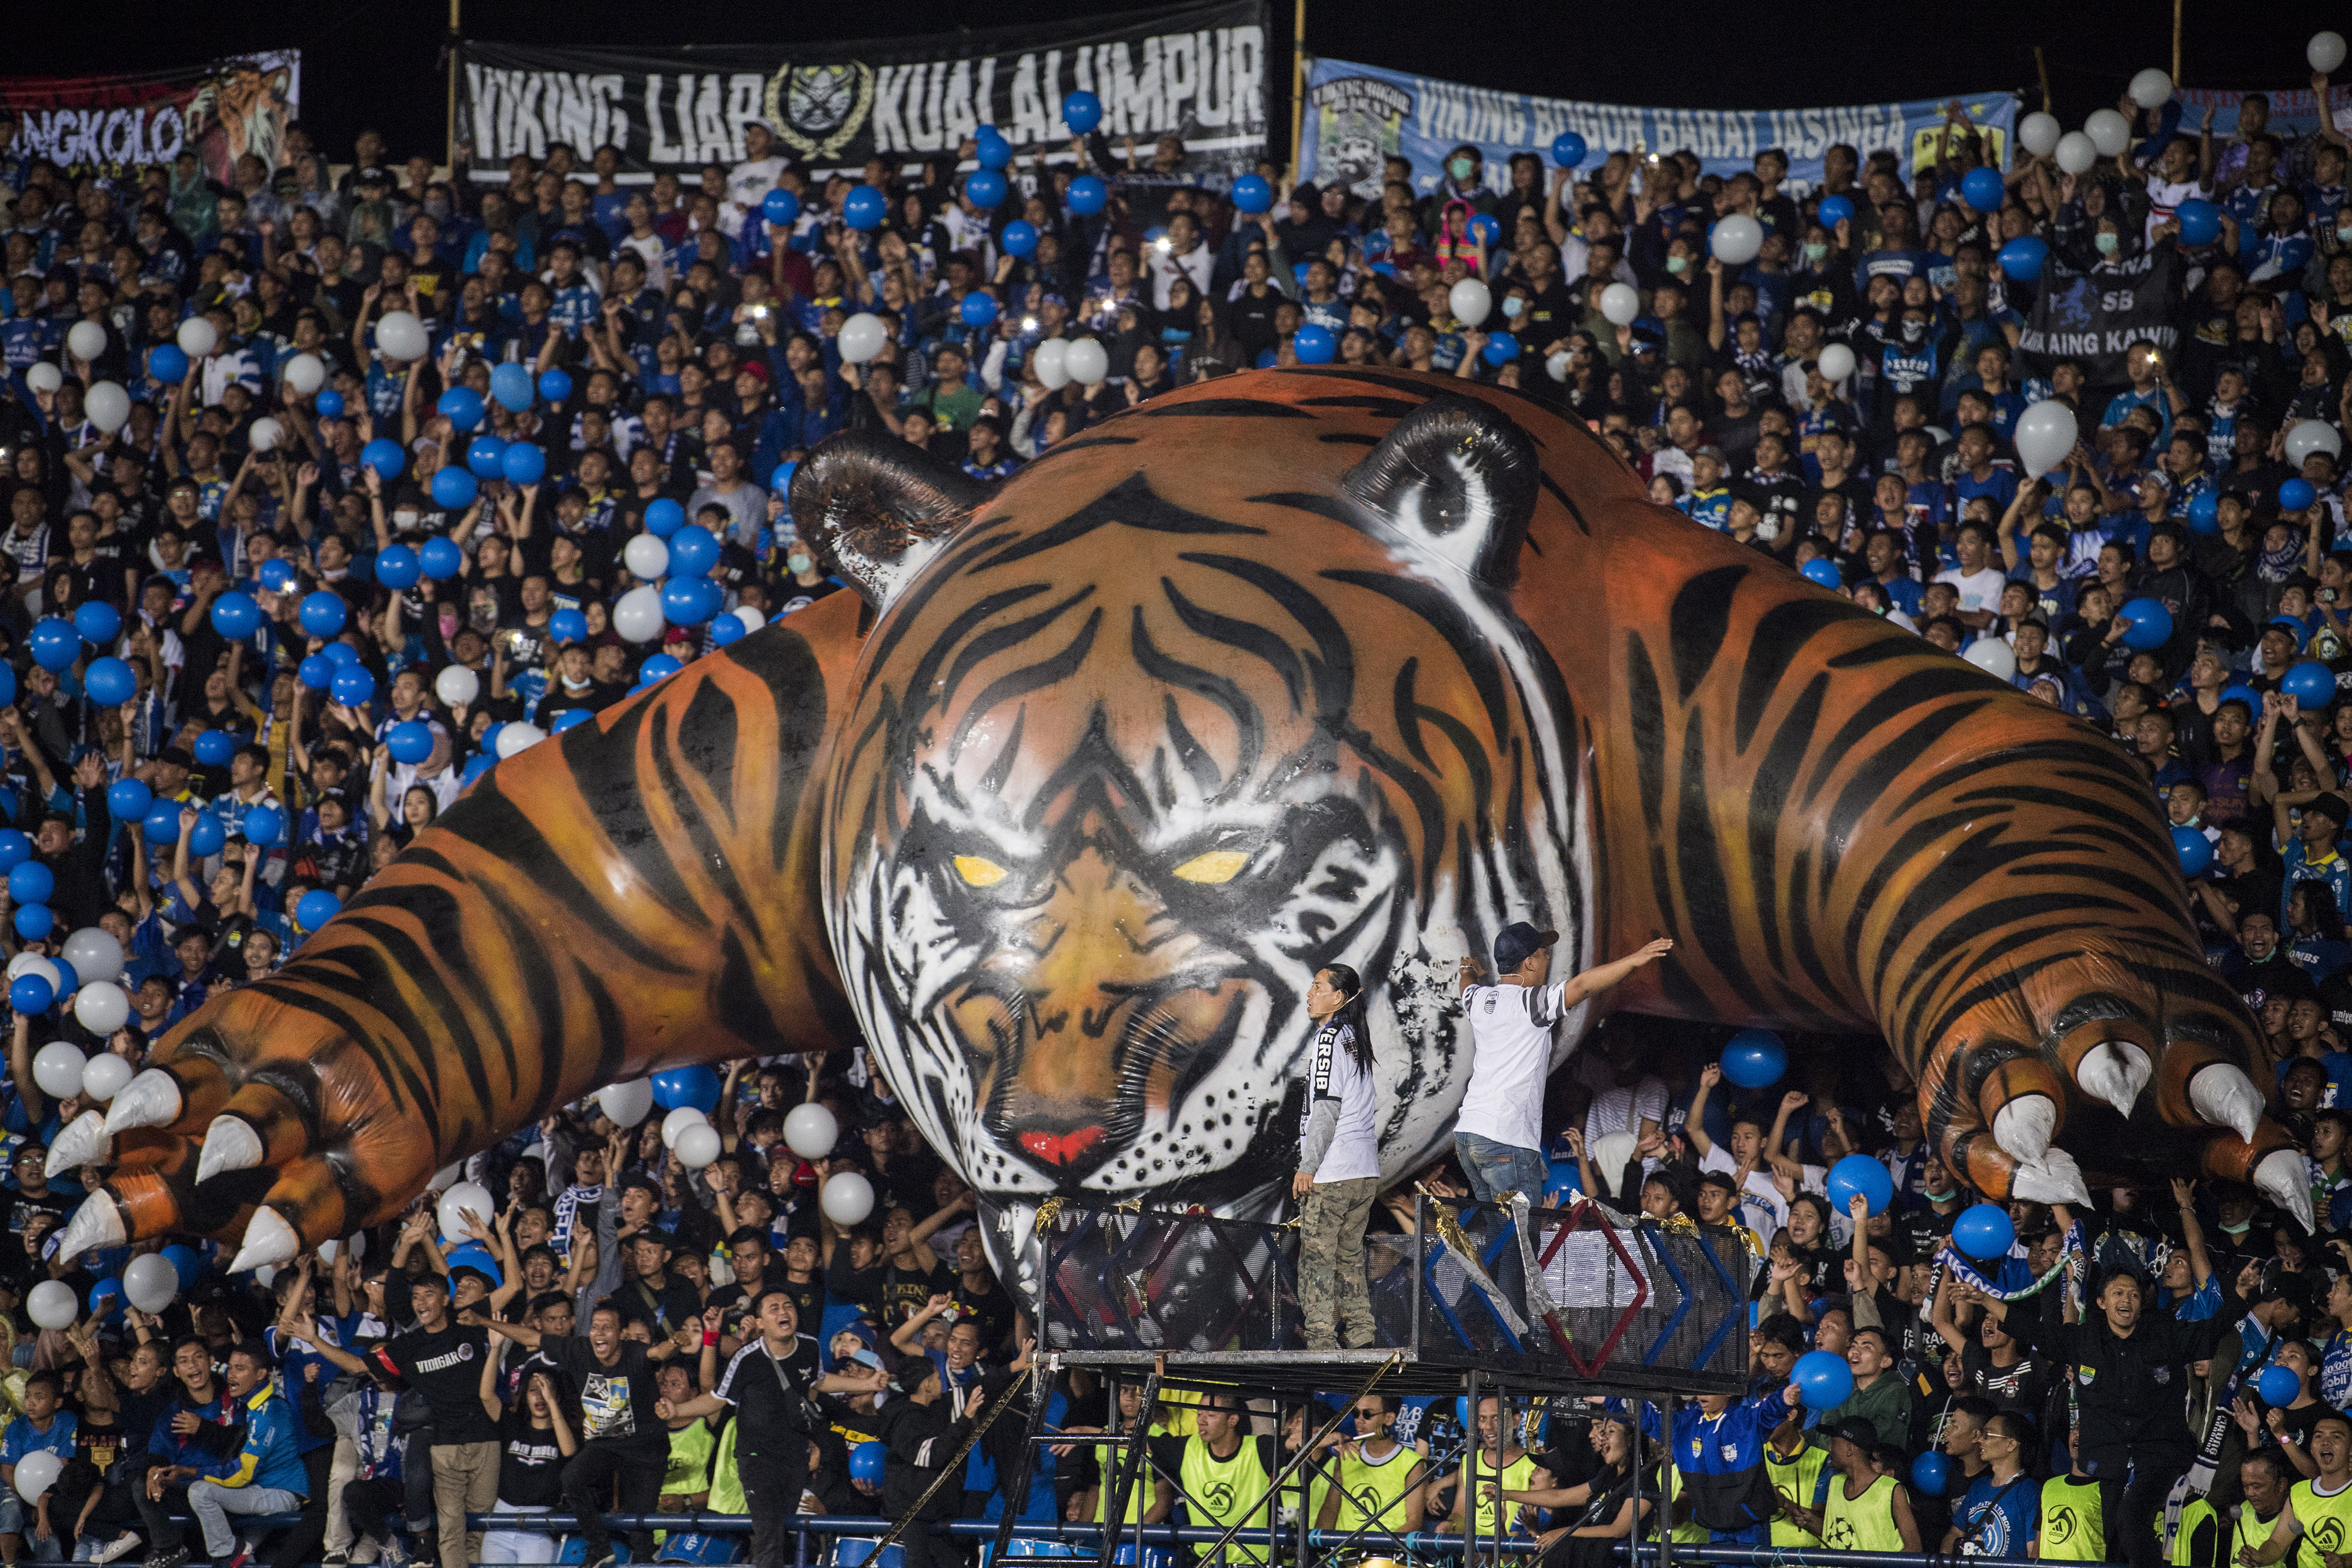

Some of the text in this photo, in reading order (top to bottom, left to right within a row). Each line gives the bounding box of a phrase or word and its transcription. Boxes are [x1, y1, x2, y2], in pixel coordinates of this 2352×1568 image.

[465, 62, 629, 162] VIKING
[646, 73, 764, 163] LIAR
[1414, 78, 1526, 146] VIKING
[1651, 108, 1758, 158] BARAT
[1768, 103, 1906, 161] JASINGA
[2100, 289, 2134, 312] SB
[2048, 332, 2099, 356] AING
[1315, 1027, 1338, 1091] PERSIB
[1977, 1500, 1999, 1509] FATHR
[1997, 1506, 2004, 1516] TO
[2002, 1515, 2011, 1532] SON
